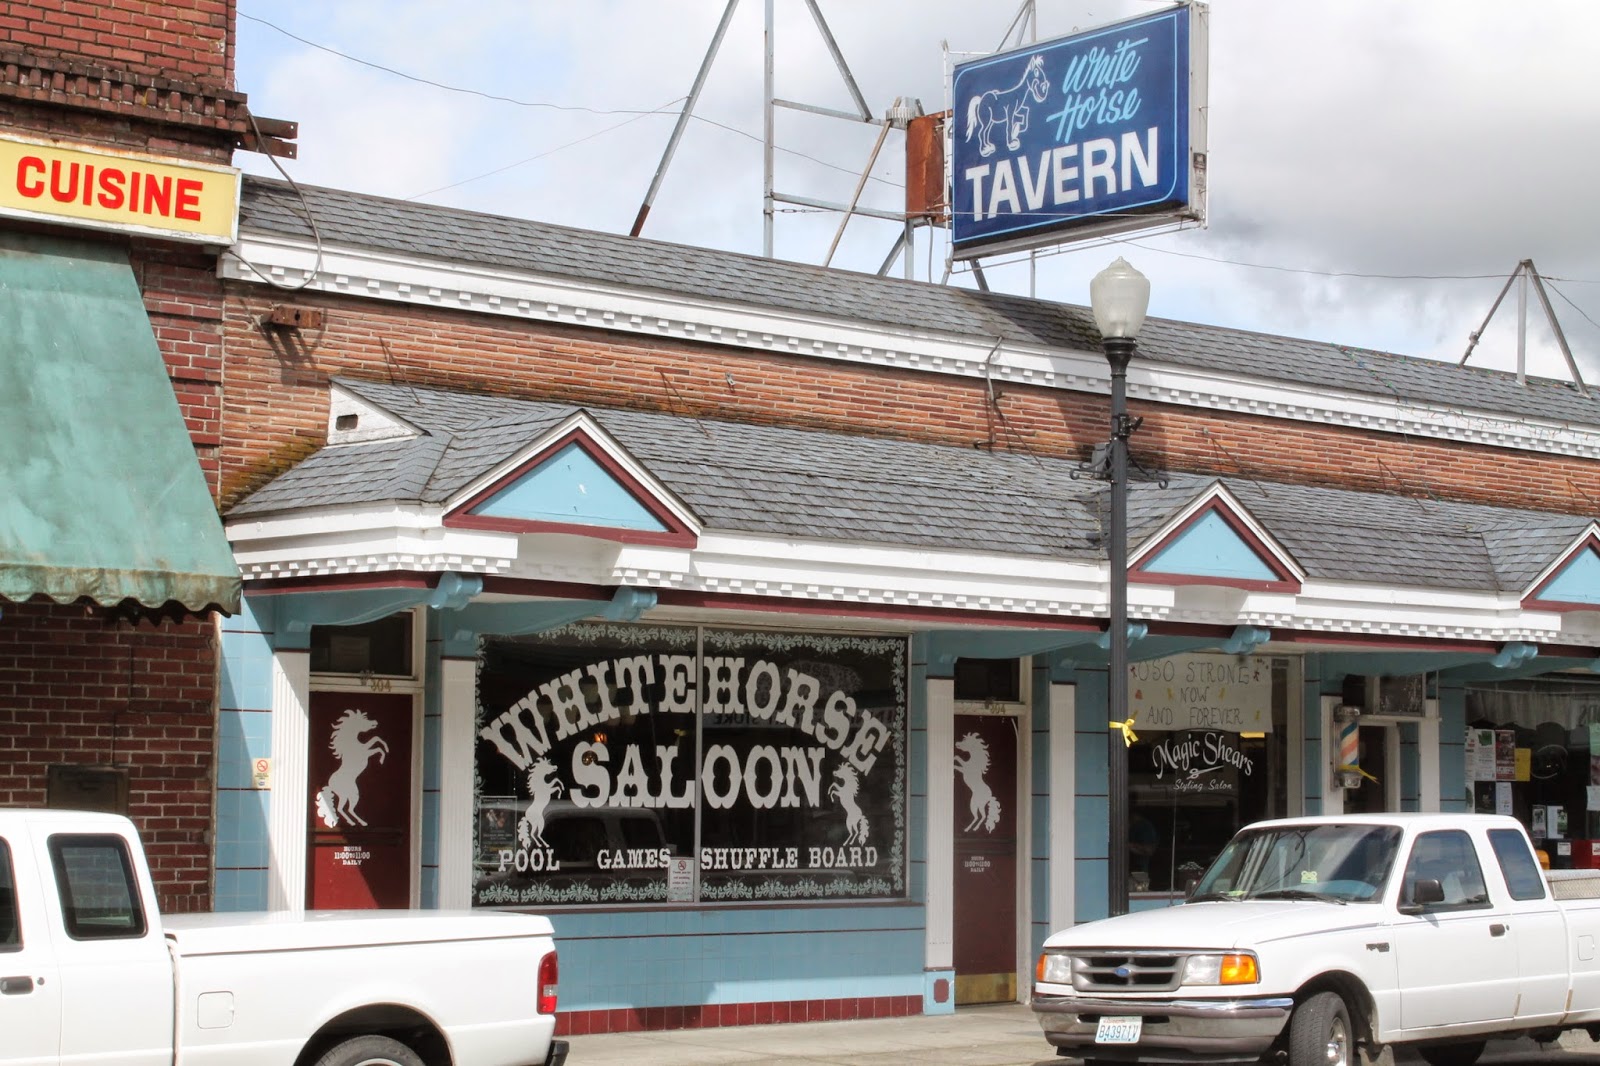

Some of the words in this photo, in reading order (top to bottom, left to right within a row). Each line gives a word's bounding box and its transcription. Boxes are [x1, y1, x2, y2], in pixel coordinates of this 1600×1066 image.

[1062, 37, 1149, 94] White
[1046, 87, 1141, 144] Horse
[16, 156, 203, 221] CUISINE
[965, 126, 1158, 222] TAVERN
[1180, 686, 1210, 703] NOW
[1186, 661, 1250, 685] STRONG
[480, 654, 891, 777] WHITEHORSE
[1146, 705, 1174, 726] AND
[1189, 706, 1244, 728] FOREVER
[570, 741, 827, 809] SALOON
[1152, 733, 1200, 780] Magic
[1203, 732, 1254, 777] Shears
[1173, 778, 1203, 793] Styling
[1207, 778, 1233, 790] Salon
[498, 848, 560, 872] POOL
[597, 847, 671, 869] GAMES
[700, 847, 798, 870] SHUFFLE
[808, 846, 879, 868] BOARD
